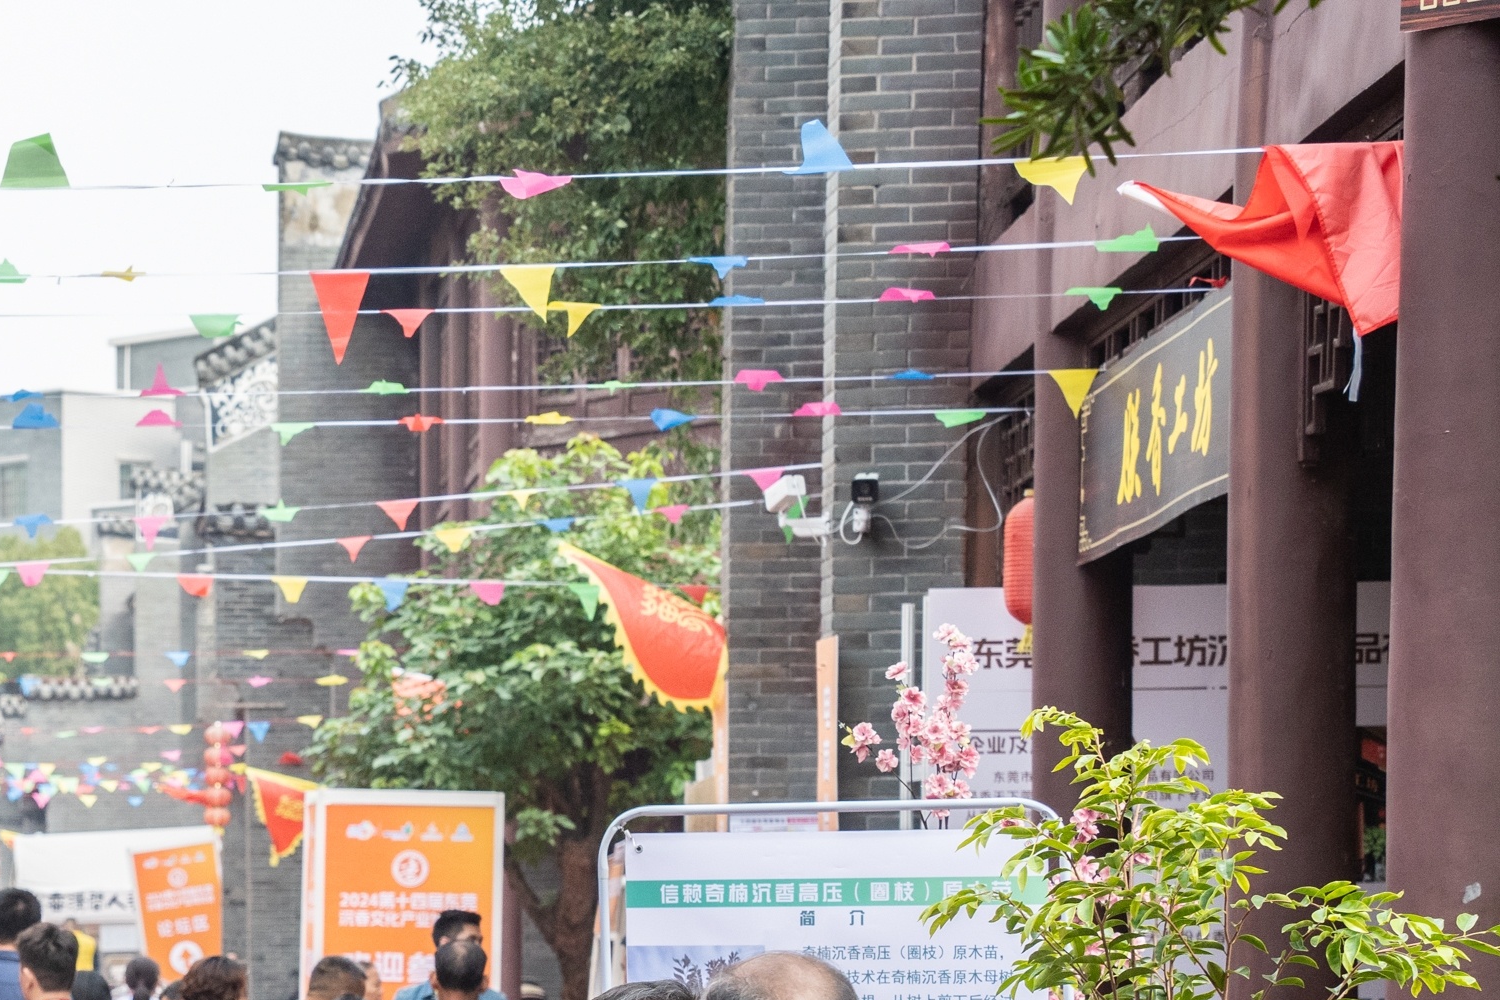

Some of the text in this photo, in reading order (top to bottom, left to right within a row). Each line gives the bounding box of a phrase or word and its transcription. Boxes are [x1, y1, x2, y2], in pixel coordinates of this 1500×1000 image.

[338, 910, 441, 928] 沉香文化产业
